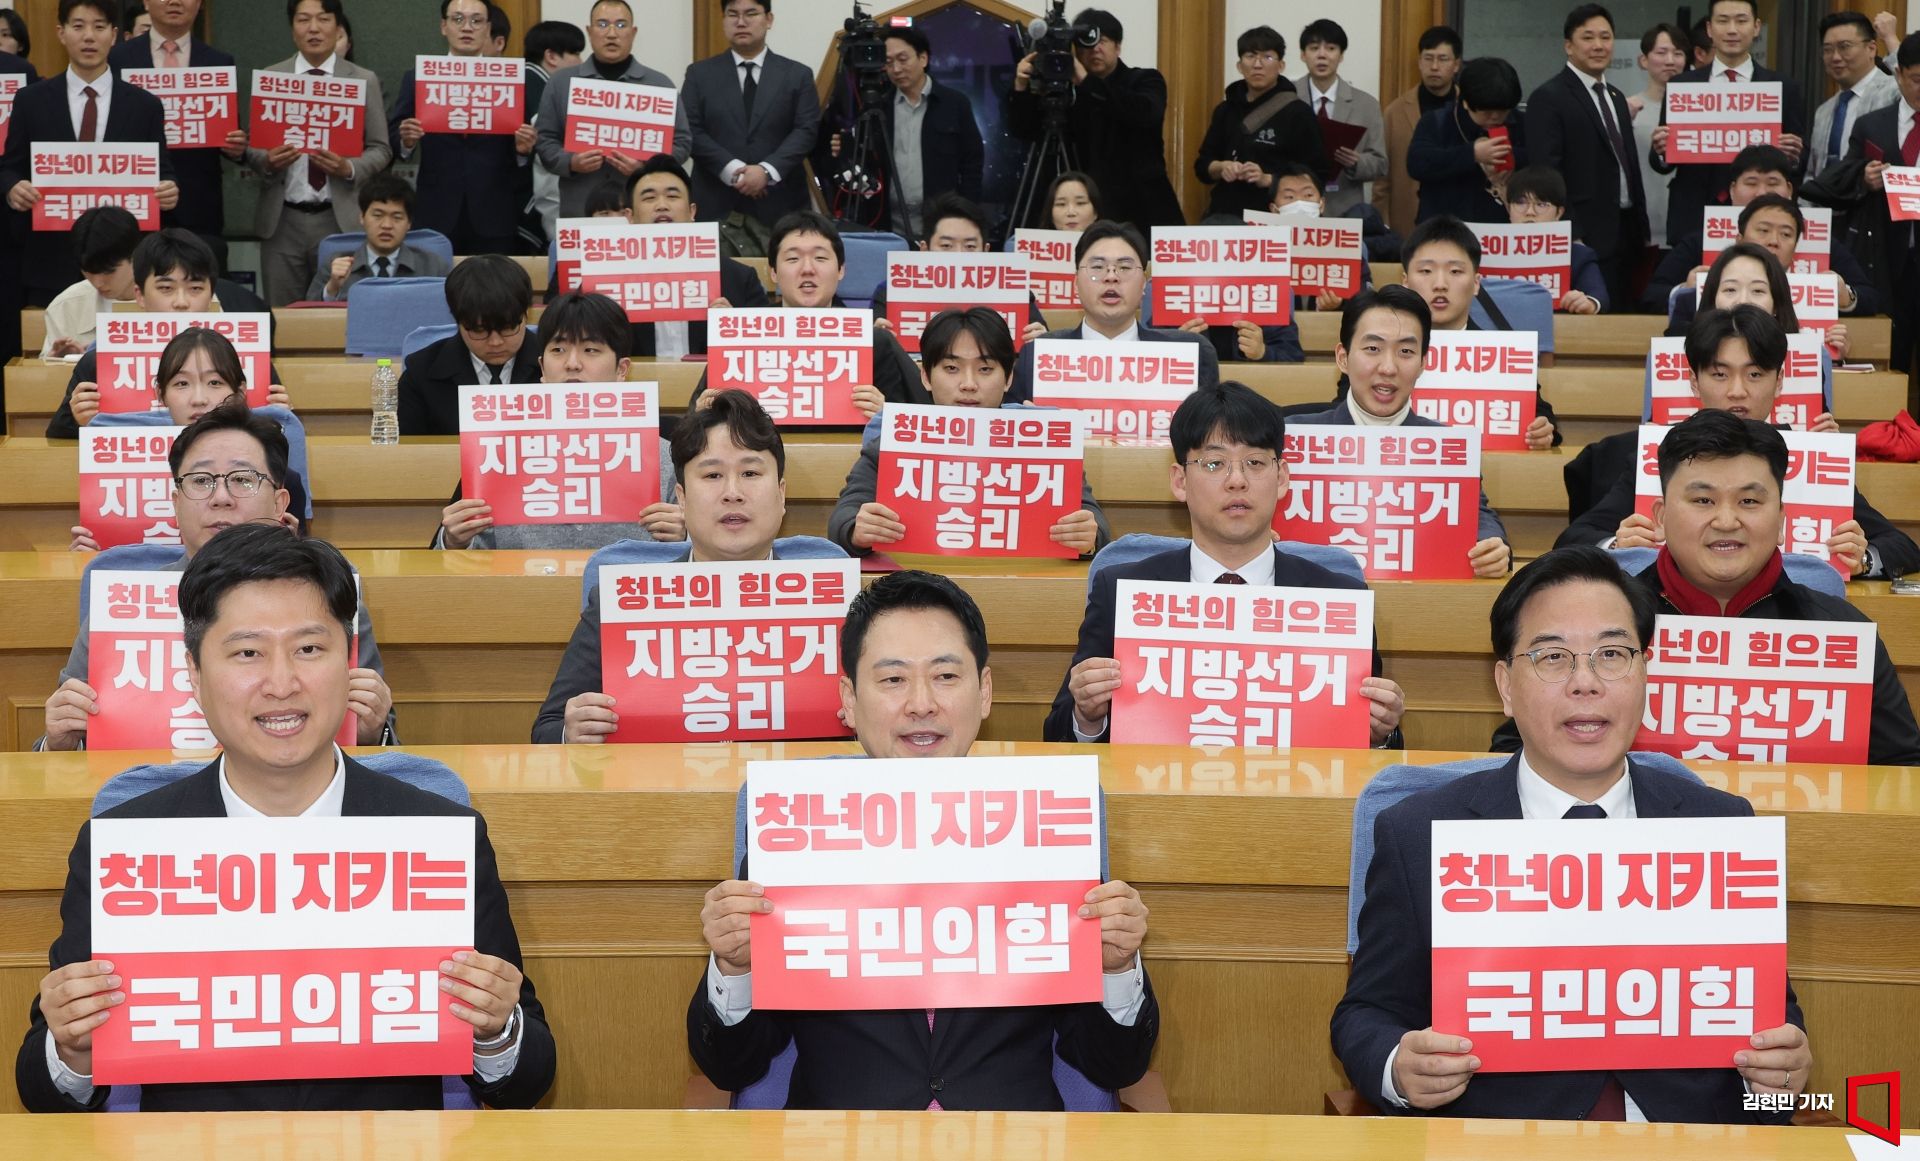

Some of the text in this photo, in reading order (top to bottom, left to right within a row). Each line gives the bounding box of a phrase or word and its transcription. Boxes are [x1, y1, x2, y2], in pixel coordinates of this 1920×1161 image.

[183, 72, 229, 89] 힘으로
[423, 60, 519, 78] 청년의 힘으로
[260, 75, 359, 99] 청년의 힘으로
[425, 83, 516, 108] 지방선거
[572, 87, 674, 116] 청년이 지키는
[1668, 92, 1780, 113] 청년이 지키는
[160, 95, 229, 120] 방선거
[260, 99, 356, 130] 지방선거
[448, 107, 493, 131] 승리
[283, 126, 331, 151] 승리
[574, 121, 665, 153] 국민의힘
[33, 153, 157, 175] 청년이 지키는
[583, 237, 648, 262] 청년이
[652, 235, 716, 260] 지키는
[1154, 239, 1288, 263] 청년이 지키는
[1303, 227, 1360, 249] 지키는
[1513, 234, 1568, 256] 지키는
[890, 264, 1027, 290] 청년이 지키는
[1164, 283, 1278, 314] 국민의힘
[107, 320, 178, 344] 청년의
[719, 316, 863, 338] 청년의 힘으로
[722, 350, 859, 383] 지방선거
[1037, 354, 1195, 385] 청년이 지키는
[1454, 346, 1534, 374] 지키는
[471, 391, 647, 422] 청년의 힘으로
[757, 385, 824, 419] 승리
[893, 413, 1072, 448] 청년의 힘으로
[92, 436, 174, 463] 청년의
[478, 432, 643, 476] 지방선거
[1284, 434, 1468, 466] 청년의 힘으로
[521, 475, 602, 519] 승리
[893, 457, 1065, 507] 지방선거
[1283, 479, 1460, 526] 지방선거
[935, 506, 1020, 551] 승리
[107, 582, 178, 620] 청년
[615, 572, 845, 610] 청년의 힘으로
[1131, 591, 1357, 635] 청년의 힘으로
[624, 624, 840, 680] 지방선거
[1748, 631, 1859, 669] 힘으로
[1135, 646, 1348, 706] 지방선거
[681, 681, 786, 733] 승리
[1642, 682, 1848, 742] 지방선거
[1188, 704, 1293, 748] 승리
[754, 788, 1094, 853] 청년이 지키는
[99, 850, 468, 917] 청년이 지키는
[1438, 851, 1780, 913] 청년이 지키는
[782, 901, 1071, 979] 국민의힘
[128, 968, 440, 1050] 국민의힘
[1465, 965, 1755, 1041] 국민의힘
